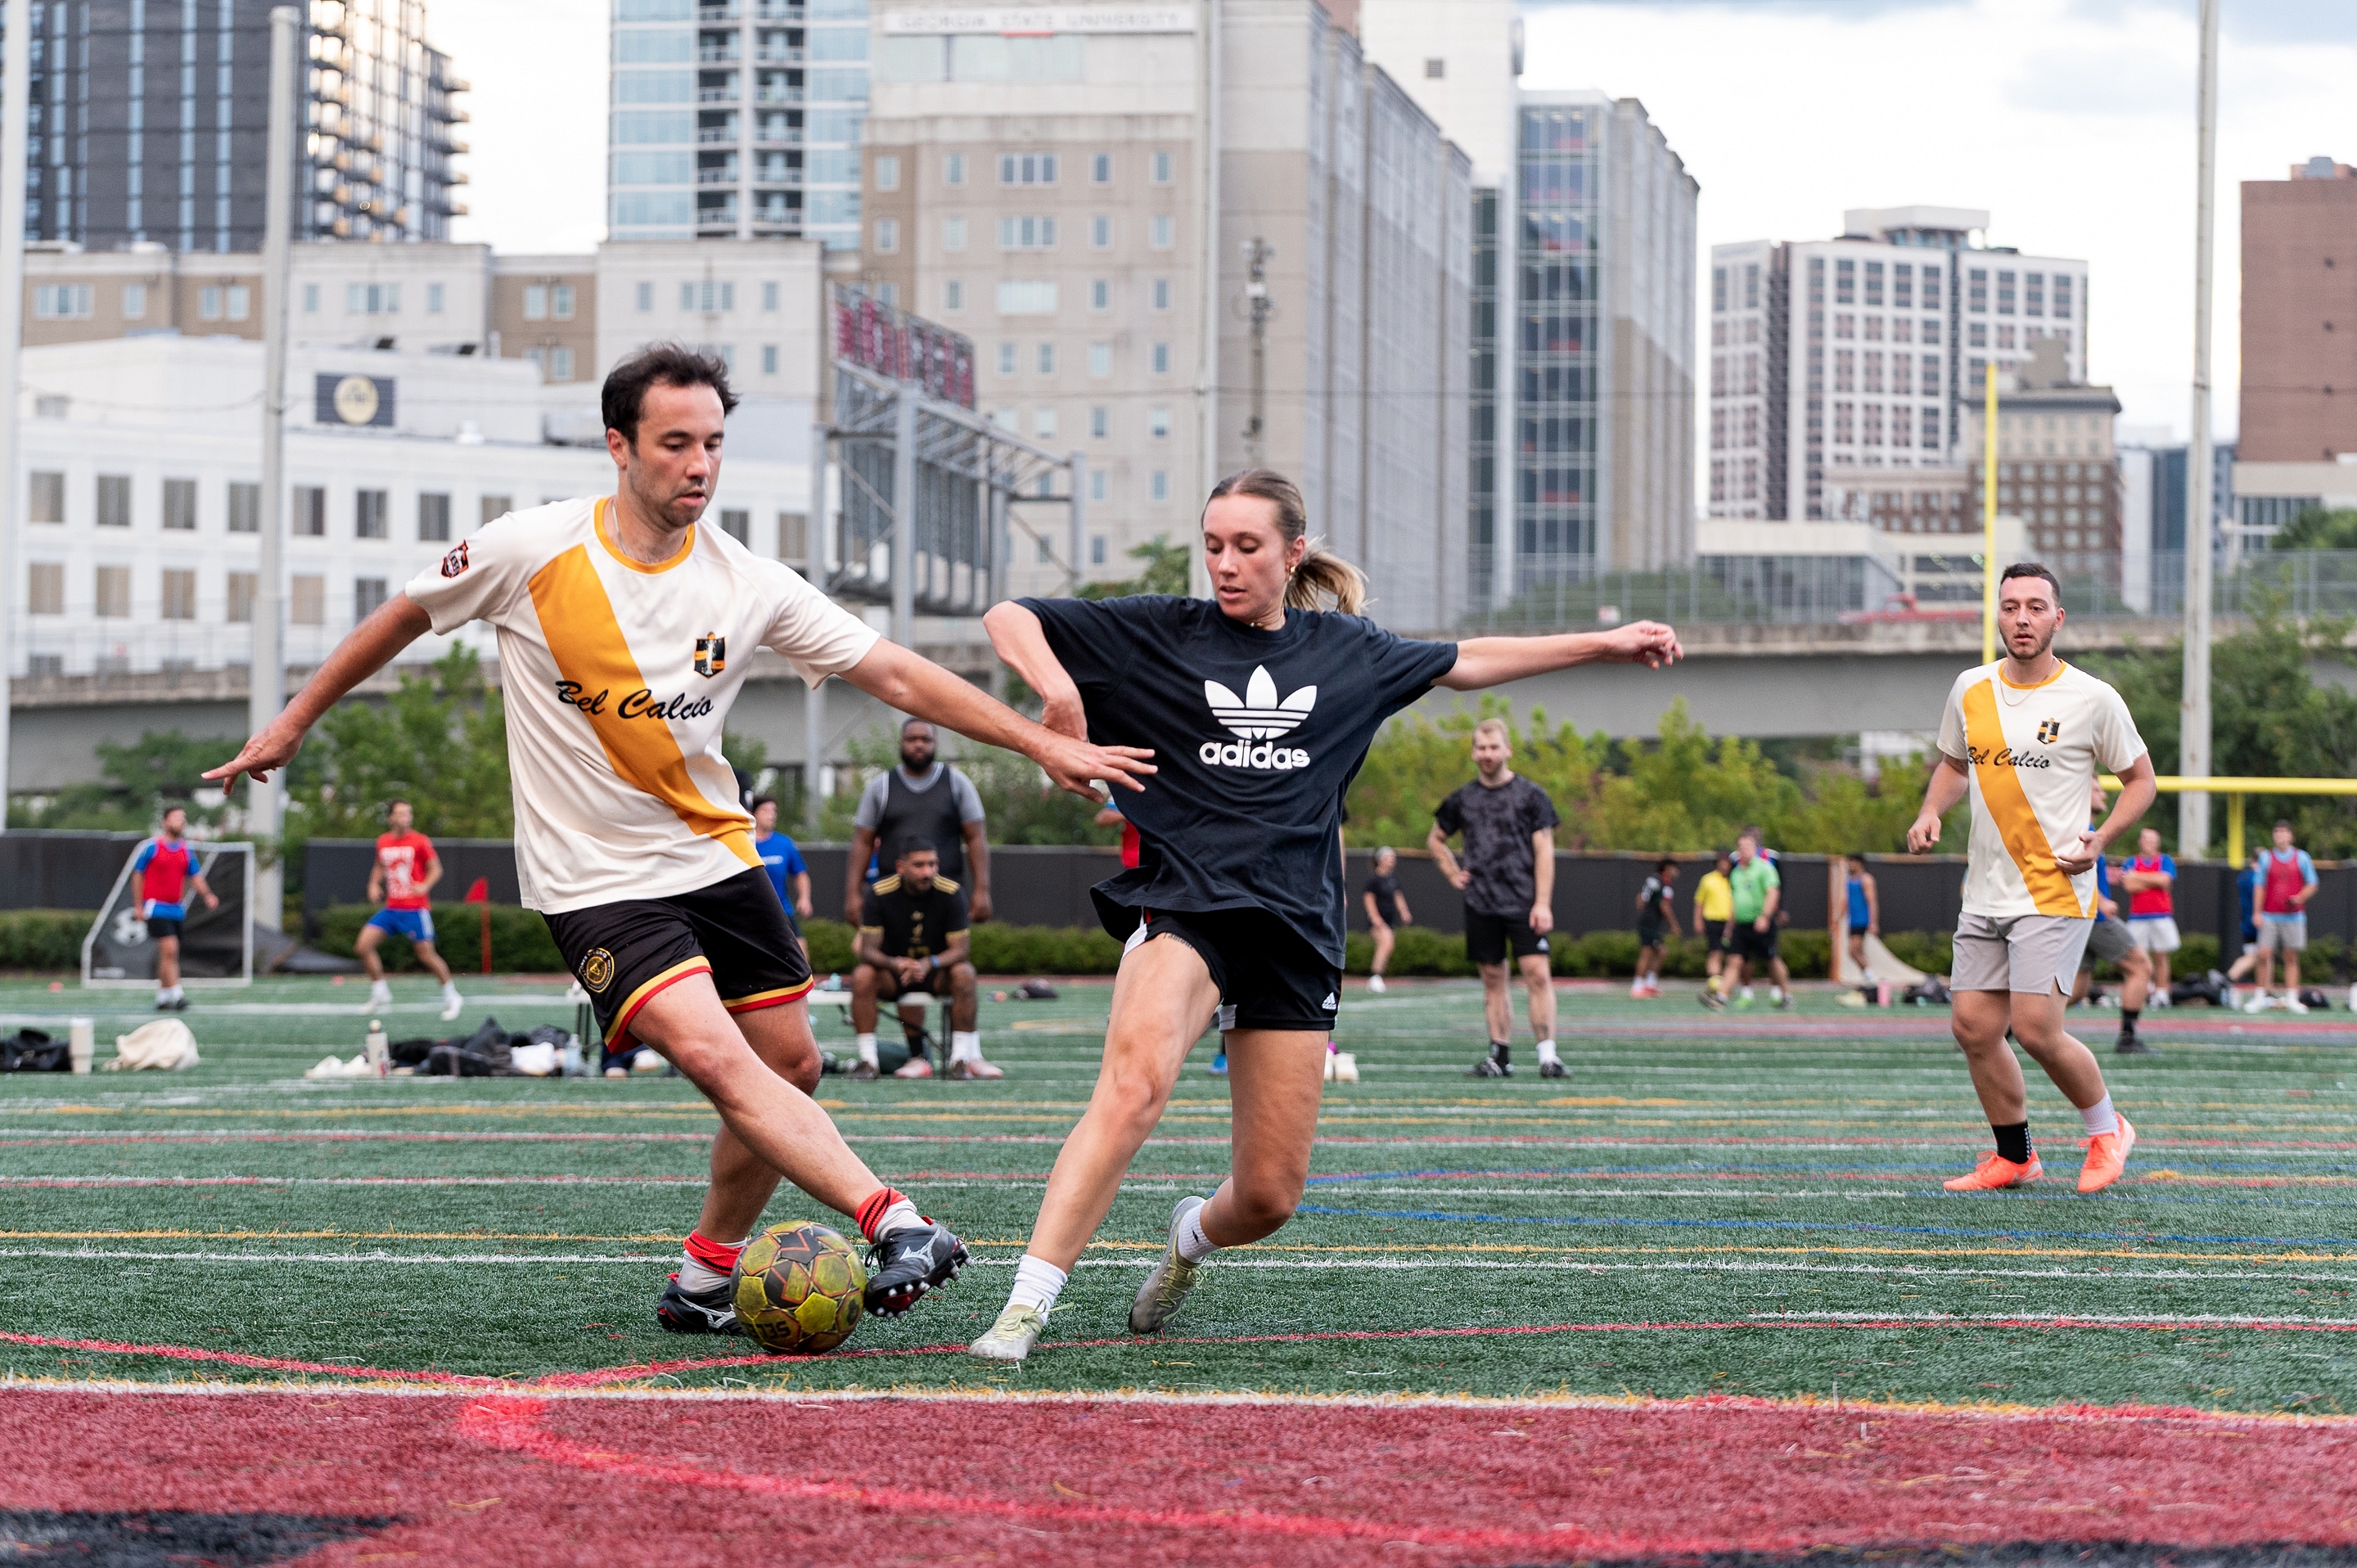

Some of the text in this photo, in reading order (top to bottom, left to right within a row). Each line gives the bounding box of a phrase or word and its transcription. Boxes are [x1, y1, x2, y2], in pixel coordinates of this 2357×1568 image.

[555, 680, 714, 720] Bel Calcio
[1199, 739, 1310, 769] adidas
[1967, 746, 2051, 769] Bel Calcio
